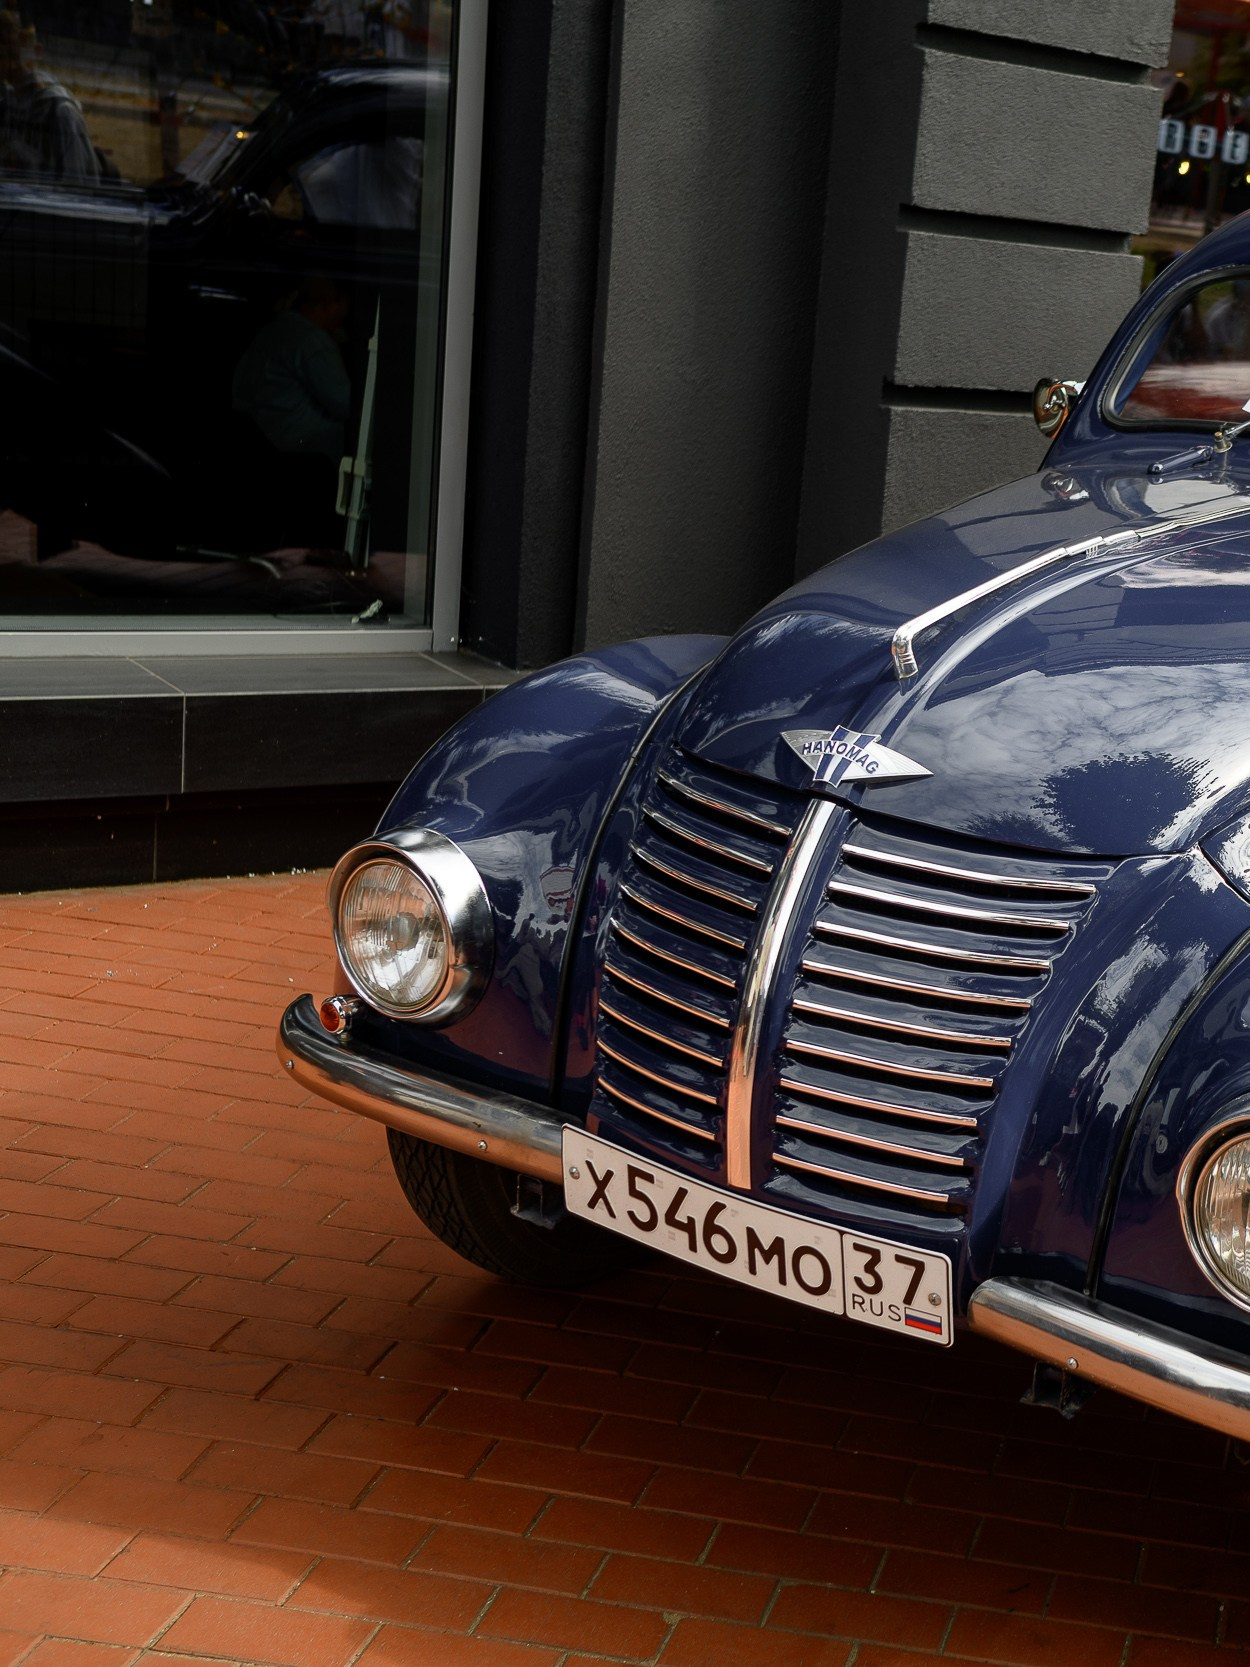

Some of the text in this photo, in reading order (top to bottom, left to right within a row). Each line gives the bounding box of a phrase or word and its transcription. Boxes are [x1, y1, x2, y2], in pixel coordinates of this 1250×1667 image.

[802, 740, 880, 775] HANOMAG
[852, 1241, 926, 1306] 37
[851, 1292, 902, 1322] RUS
